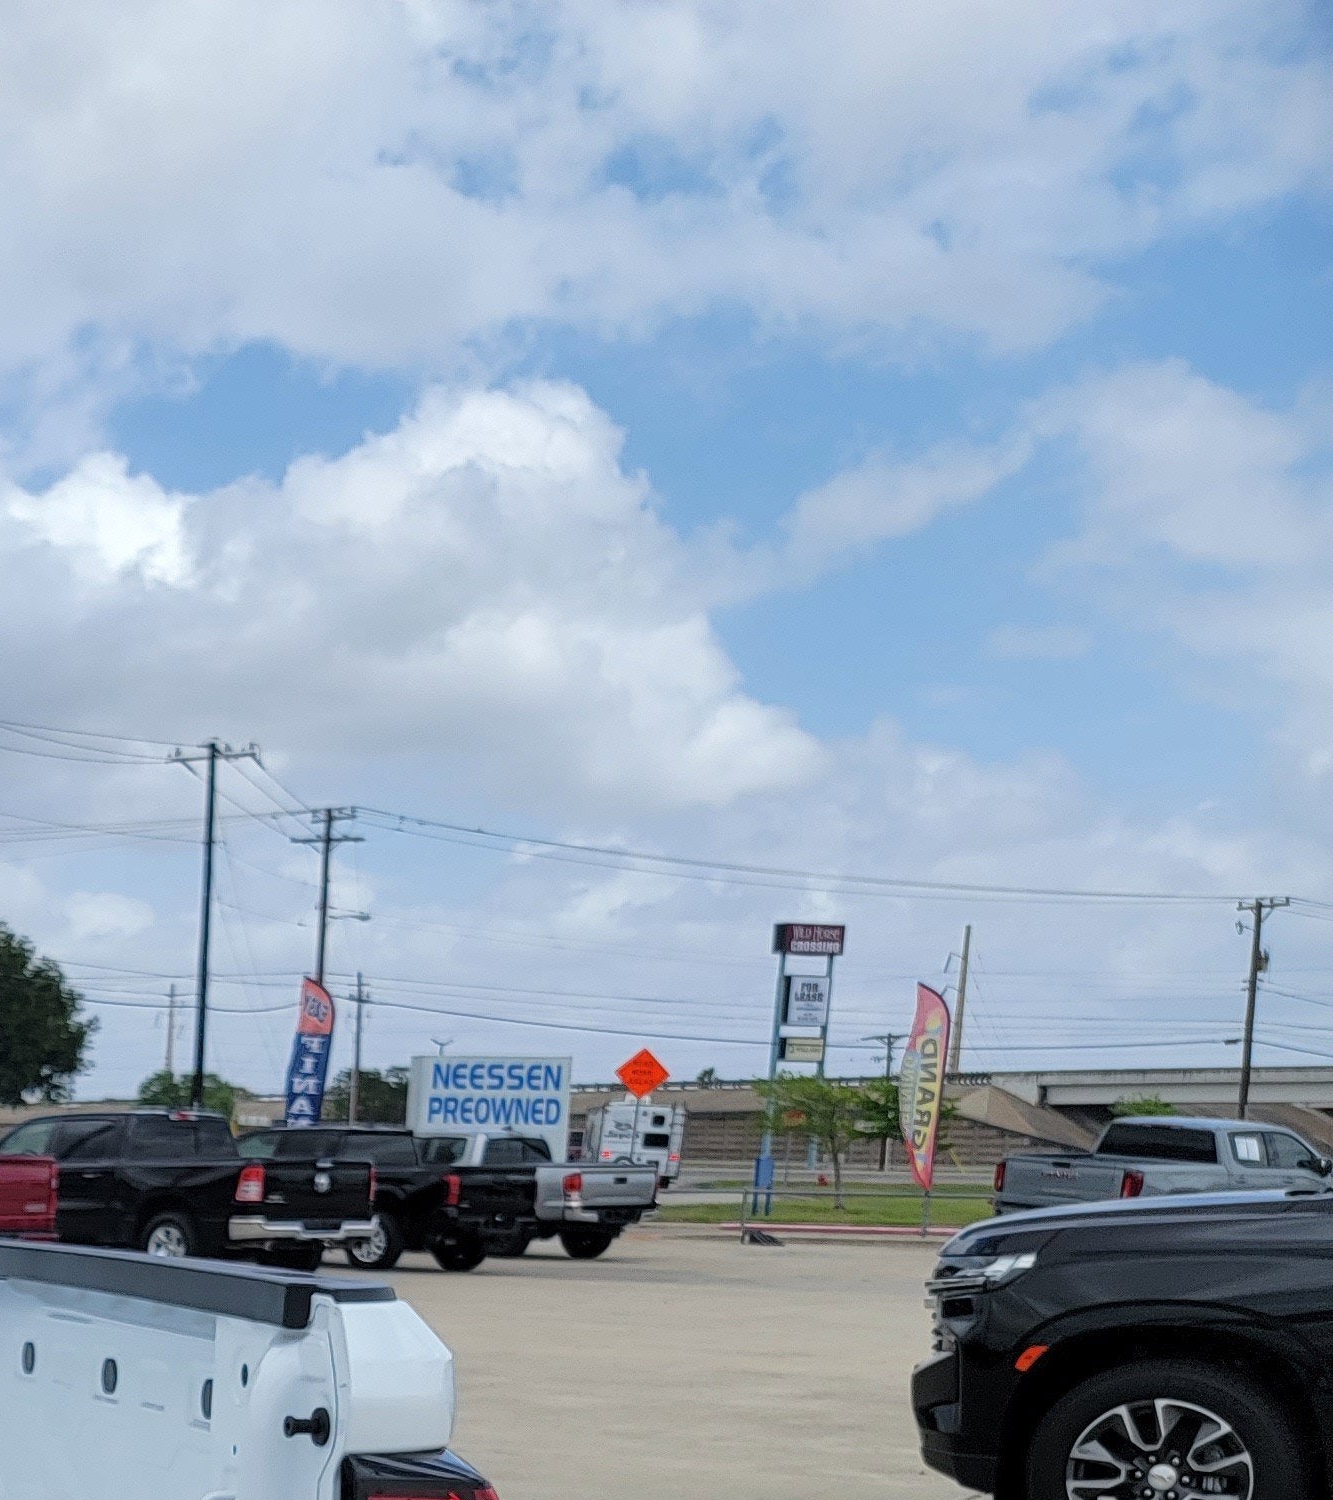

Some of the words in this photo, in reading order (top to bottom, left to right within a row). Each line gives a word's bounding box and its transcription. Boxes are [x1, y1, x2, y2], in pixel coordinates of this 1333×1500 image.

[791, 940, 840, 953] CROSSING
[800, 982, 819, 992] FOR
[794, 992, 824, 1002] LEASE
[432, 1063, 562, 1091] NEESSEN
[427, 1096, 561, 1126] PREOWNED
